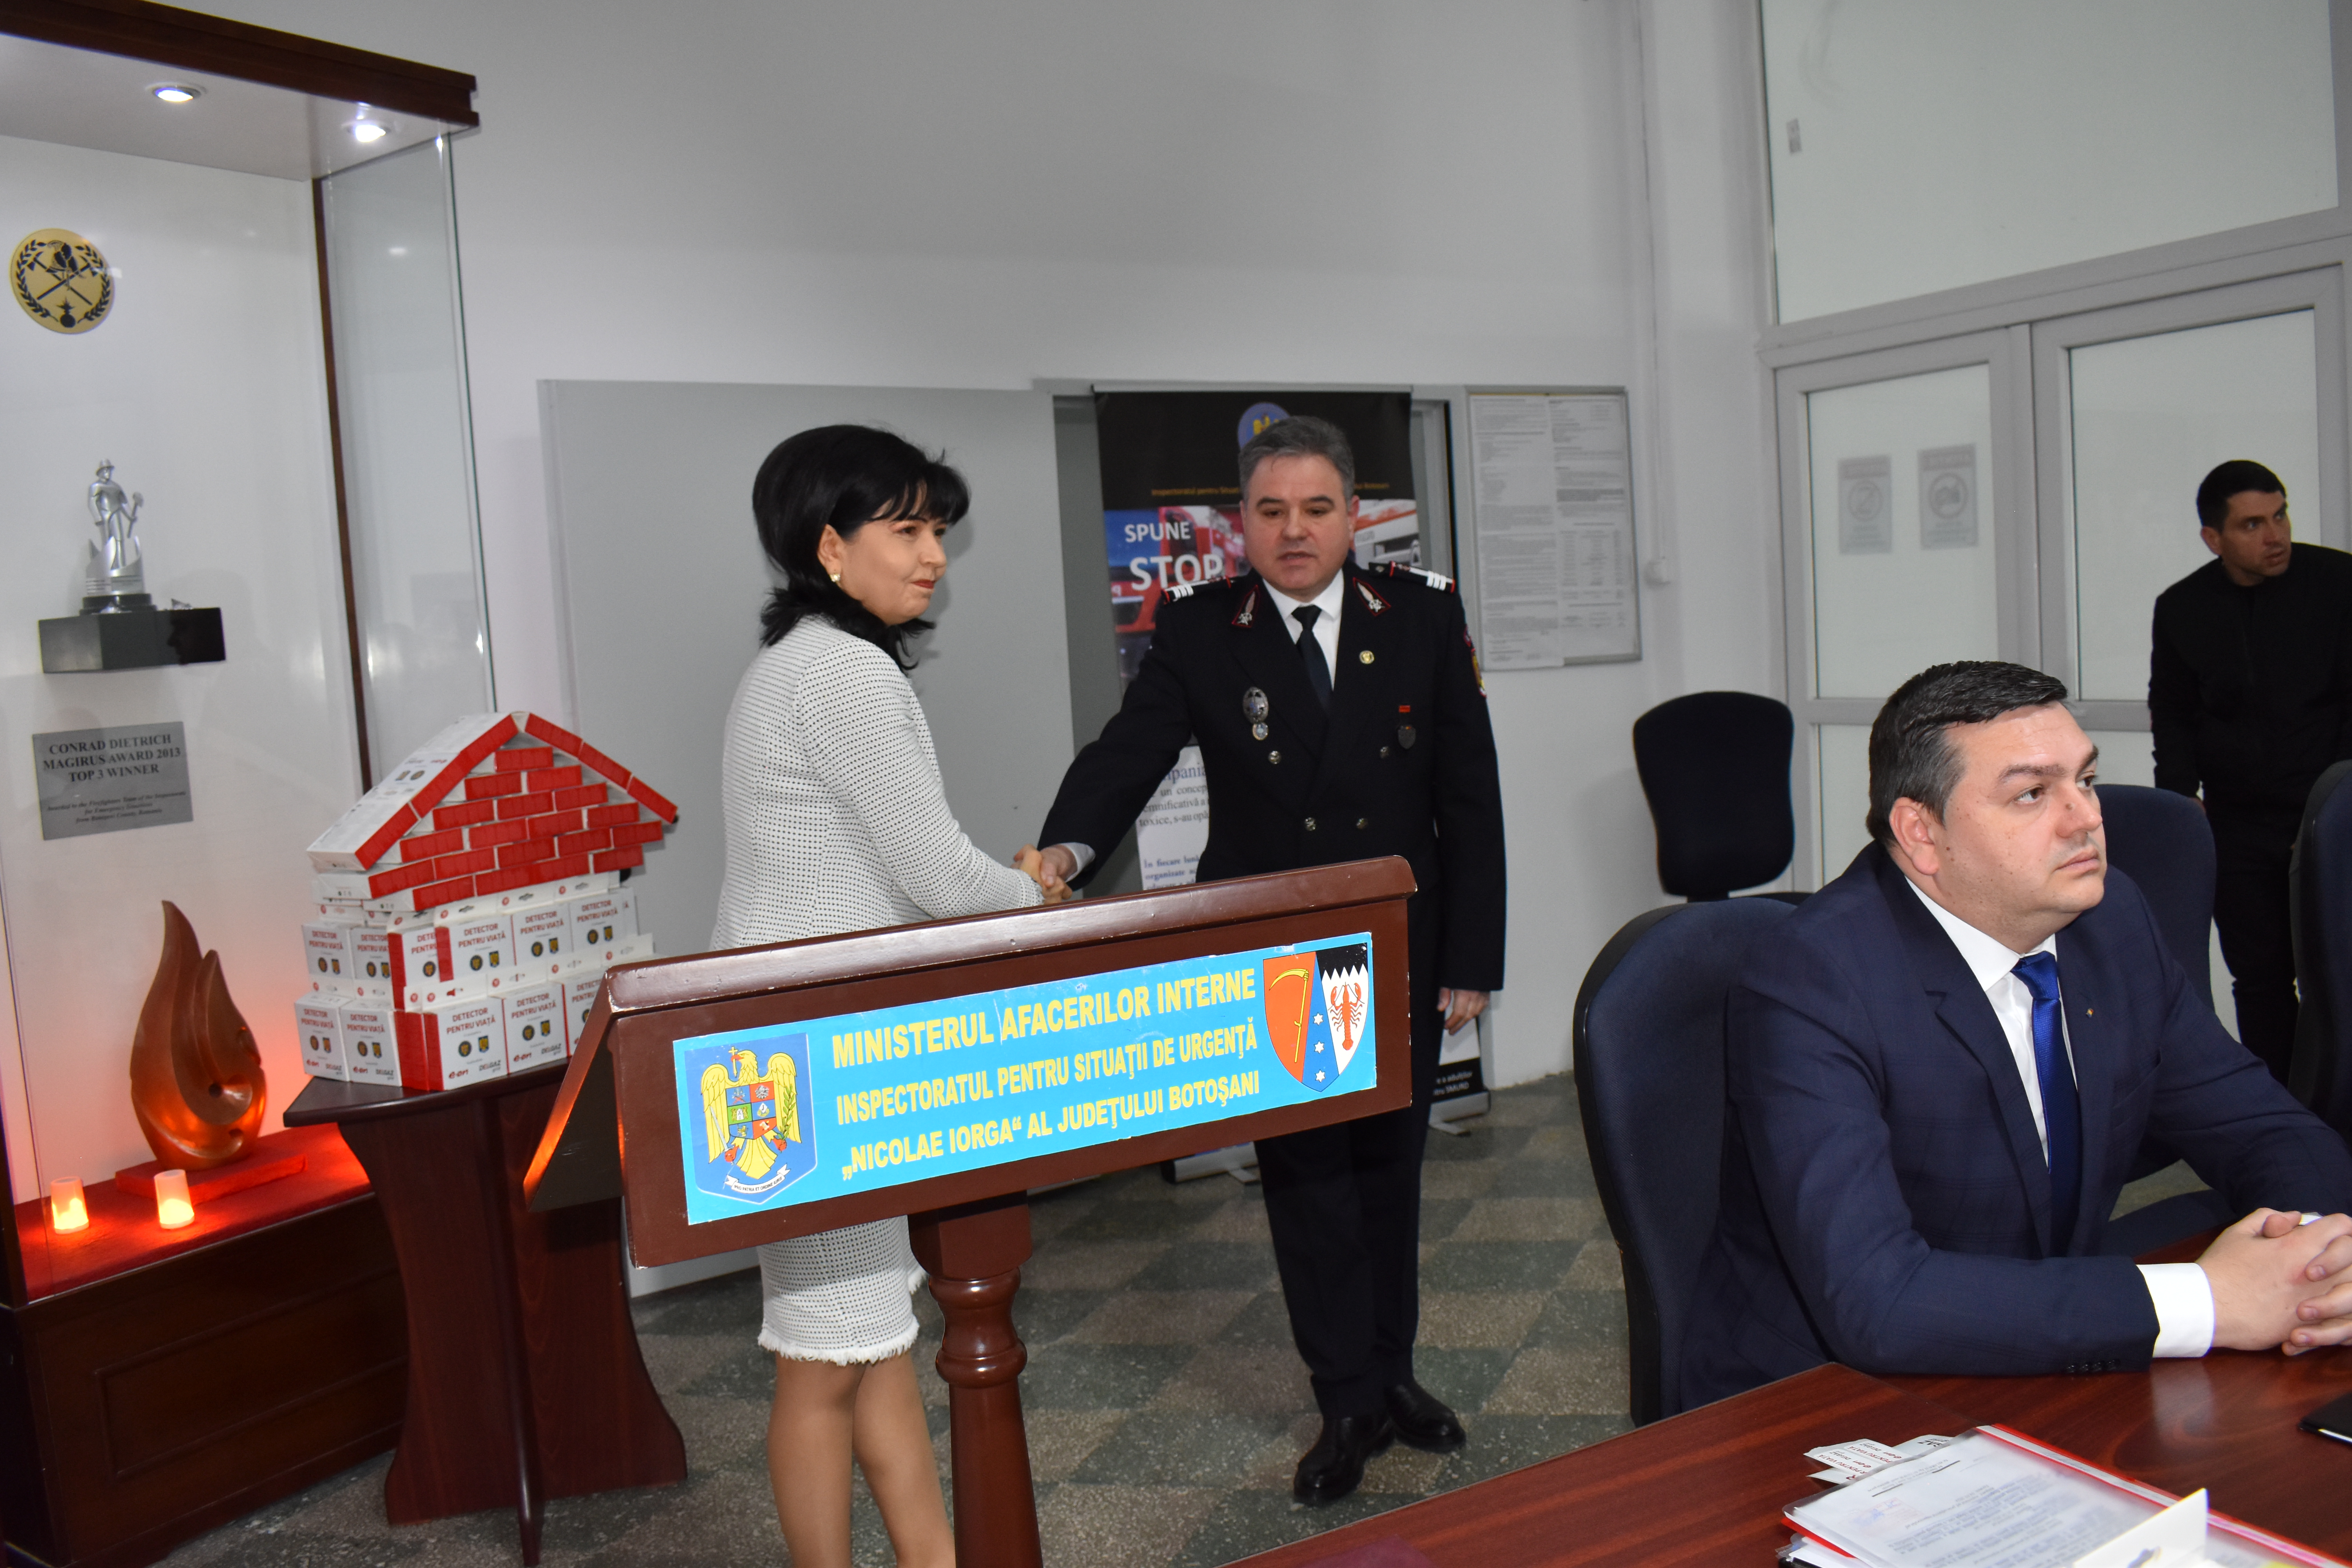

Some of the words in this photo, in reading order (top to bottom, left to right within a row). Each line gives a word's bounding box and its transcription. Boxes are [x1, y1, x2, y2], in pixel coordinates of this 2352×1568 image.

[1124, 521, 1191, 543] SPUNE
[1129, 554, 1223, 591] STOP
[49, 740, 106, 755] CONRAD
[109, 734, 171, 750] DIETRICH
[44, 754, 106, 770] MAGIRUS
[109, 750, 153, 764] AWARD
[157, 747, 181, 759] 2013
[68, 770, 95, 782] TOP
[97, 769, 104, 779] 3
[107, 764, 159, 777] WINNER
[417, 932, 435, 942] DETE
[832, 1012, 995, 1069] MINISTERUL
[1002, 985, 1151, 1040] AFACERILOR
[1157, 968, 1256, 1014] INTERNE
[837, 1070, 993, 1125] INSPECTORATUL
[998, 1056, 1069, 1096] PENTRU
[1152, 1037, 1175, 1068] DE
[1027, 1111, 1053, 1138] AL
[1836, 1461, 1860, 1472] PENTRU
[1866, 1453, 1893, 1463] PENTRU
